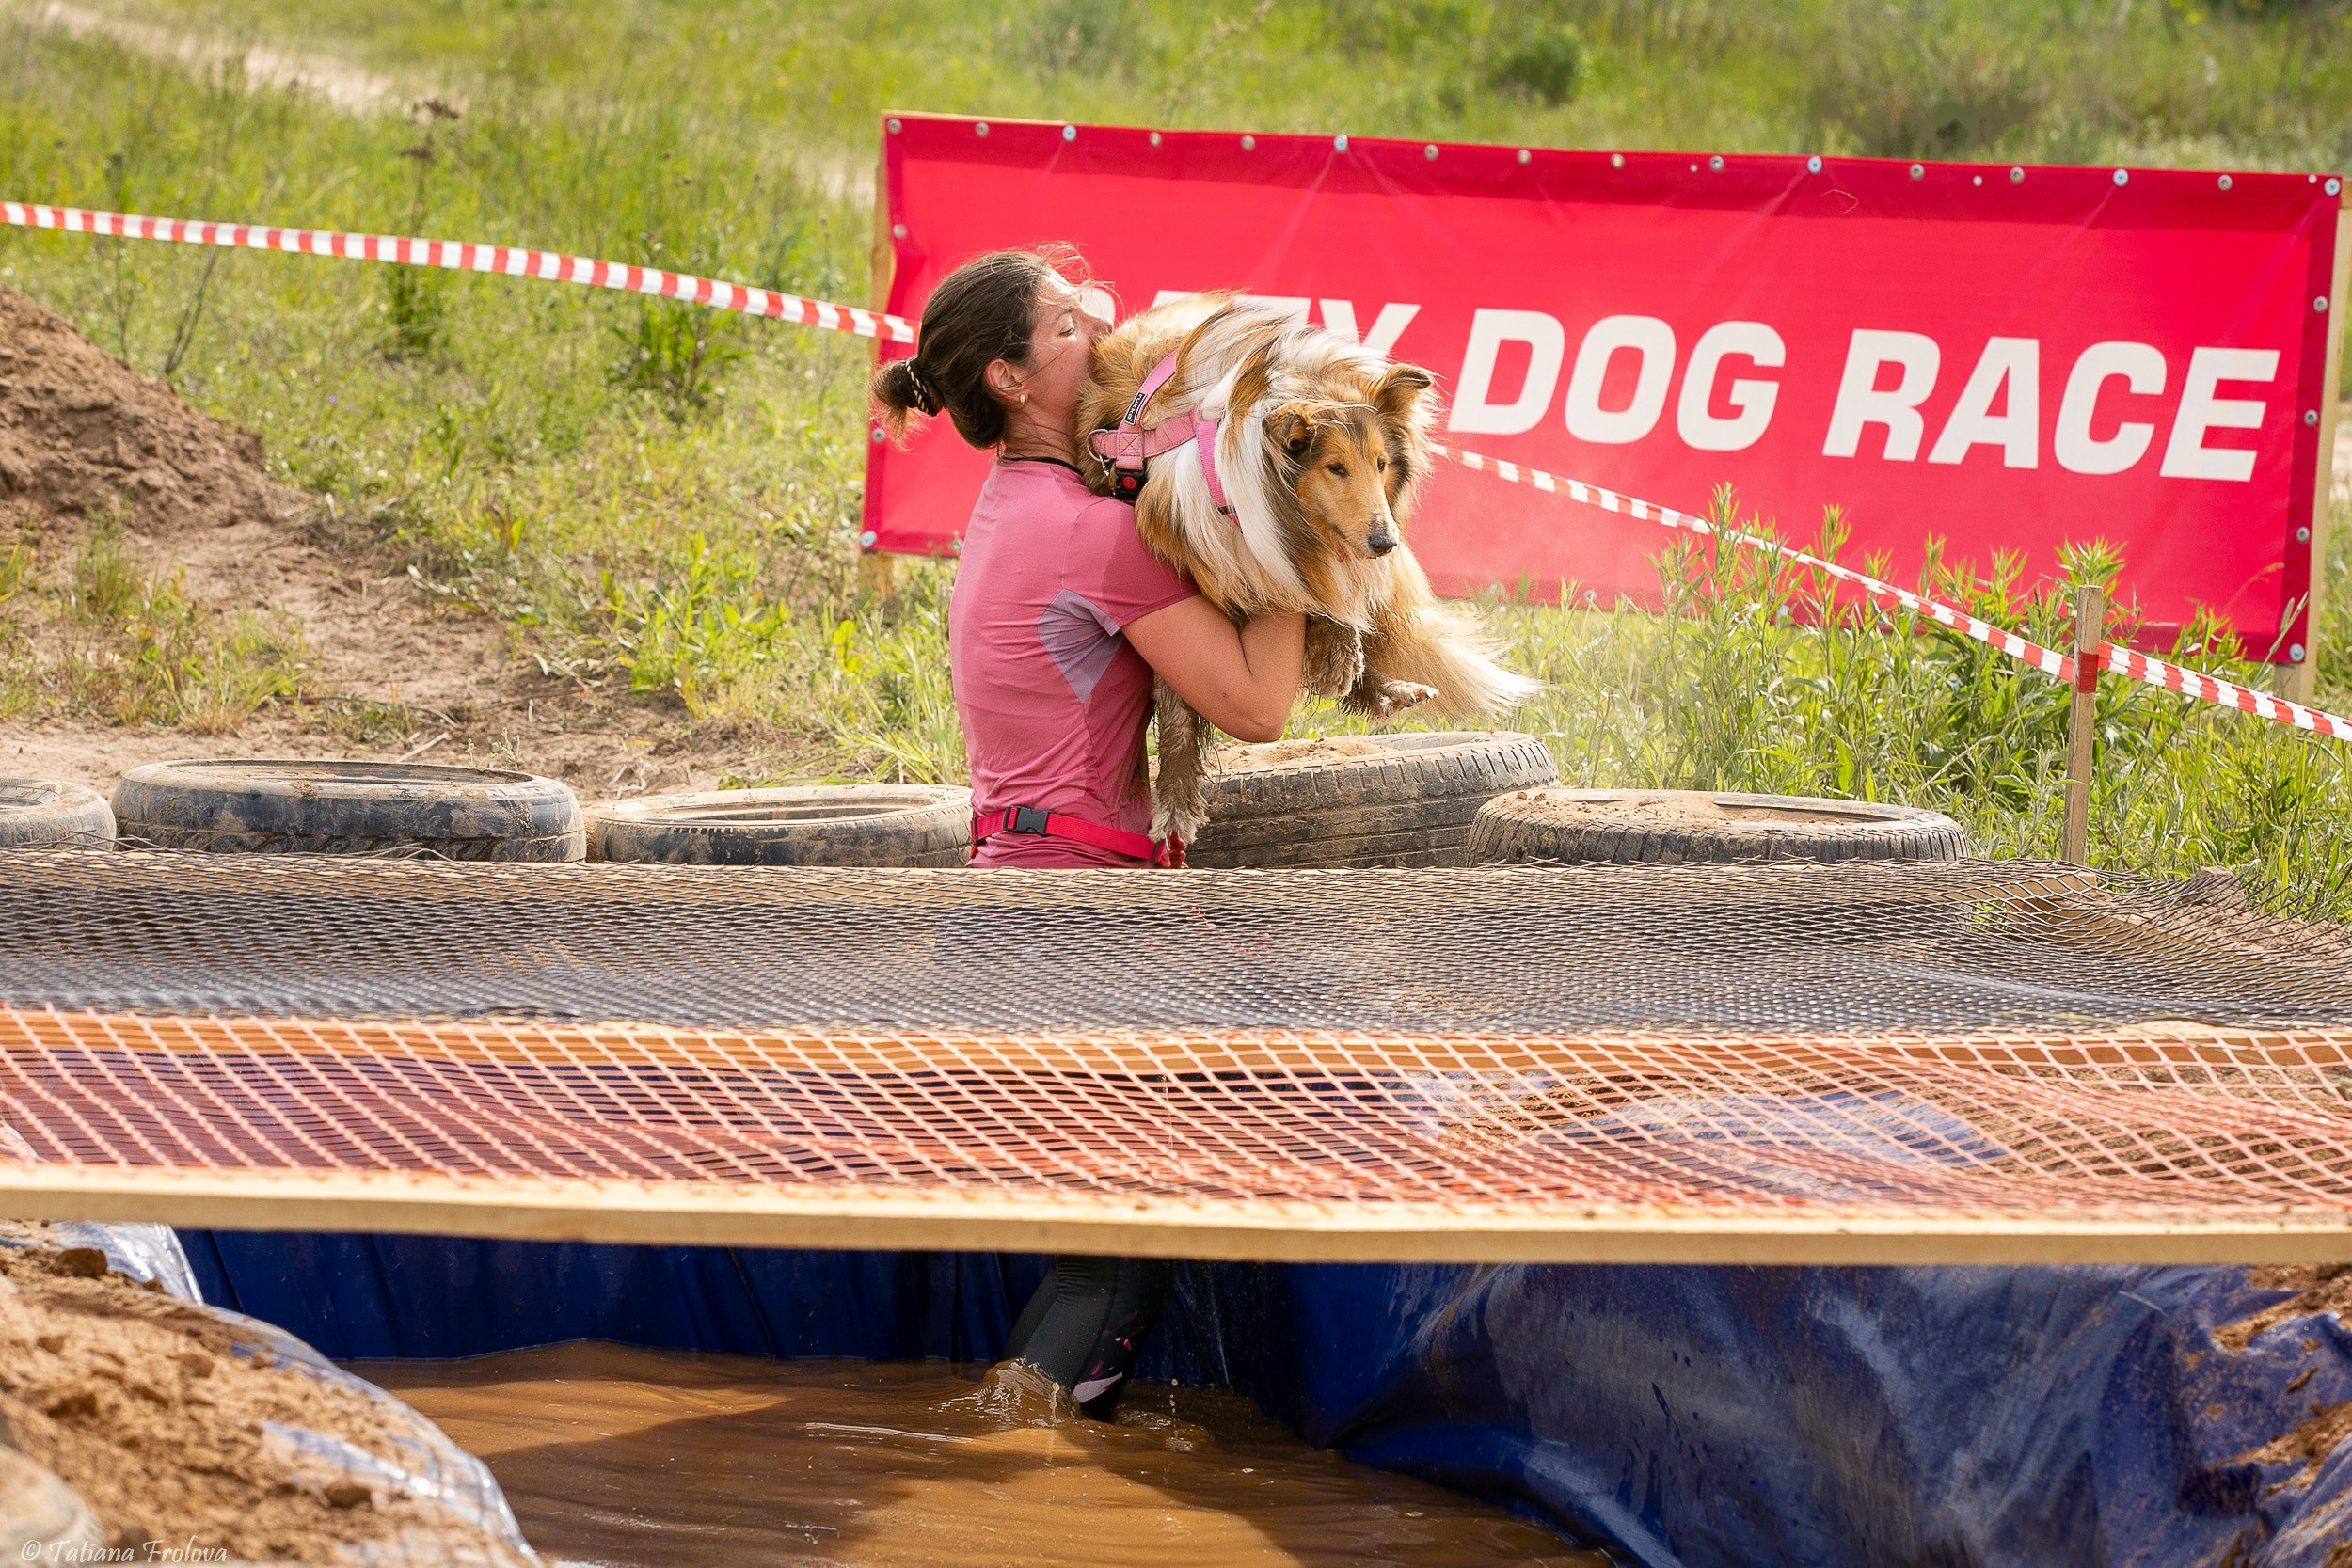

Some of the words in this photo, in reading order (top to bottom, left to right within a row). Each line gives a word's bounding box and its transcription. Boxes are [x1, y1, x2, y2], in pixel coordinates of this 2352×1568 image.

[1126, 394, 1142, 420] rukka
[1447, 308, 1786, 451] DOG
[1821, 328, 2280, 483] RACE
